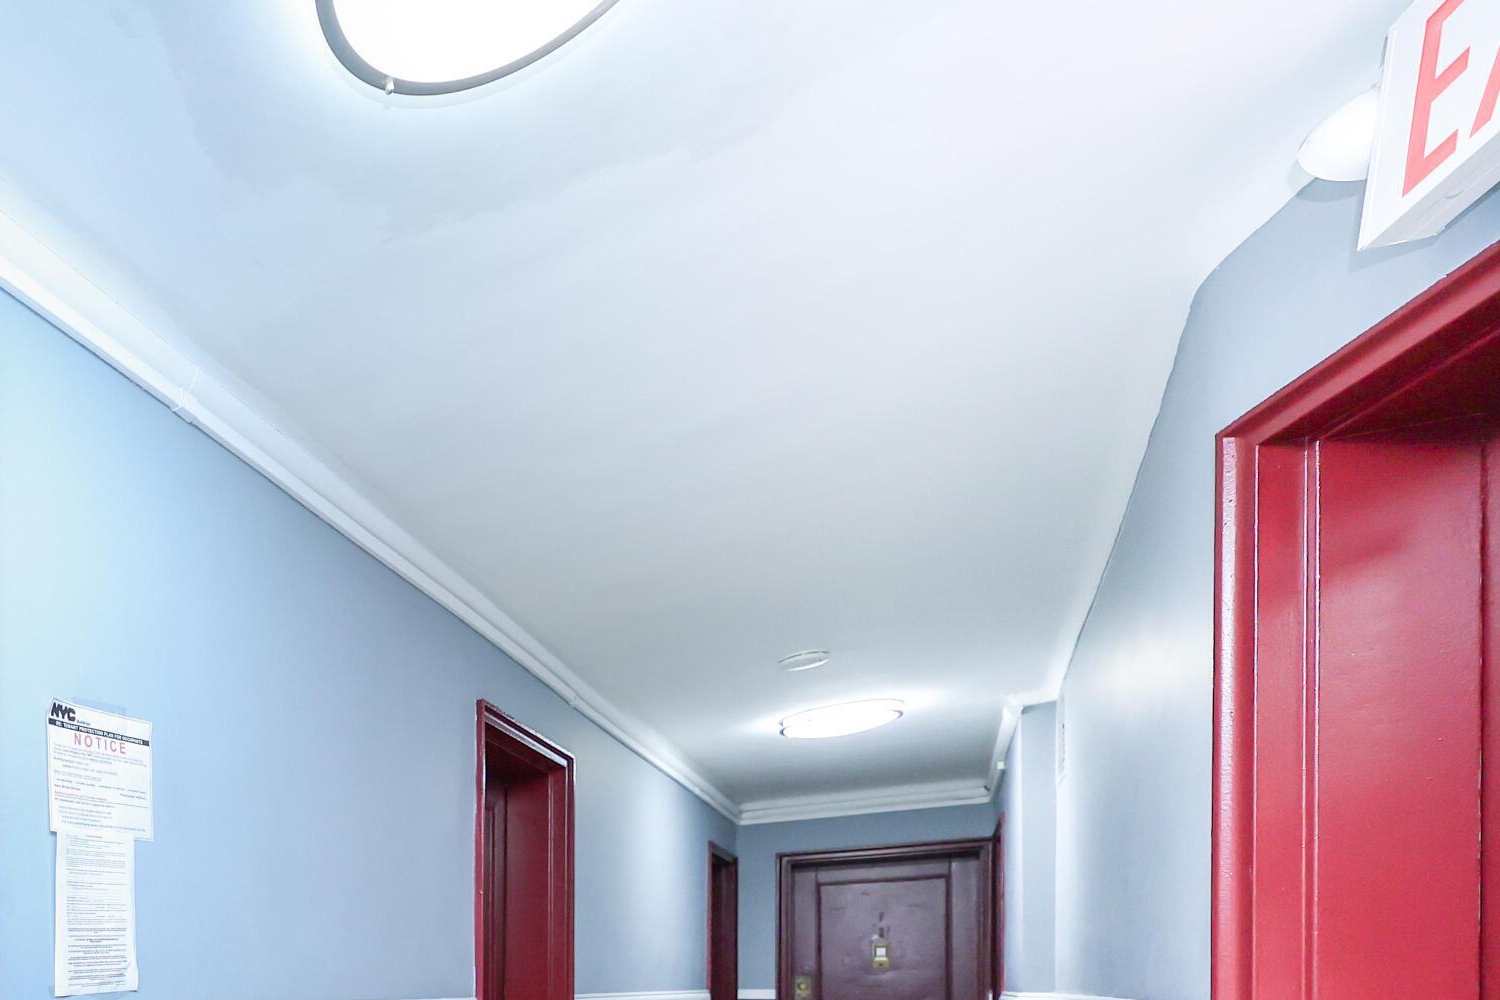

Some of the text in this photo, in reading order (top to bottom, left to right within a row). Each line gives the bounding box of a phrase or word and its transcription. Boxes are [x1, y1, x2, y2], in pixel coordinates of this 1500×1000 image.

[1402, 0, 1500, 198] E
[50, 702, 76, 721] NYC
[74, 733, 127, 754] NOTICE
